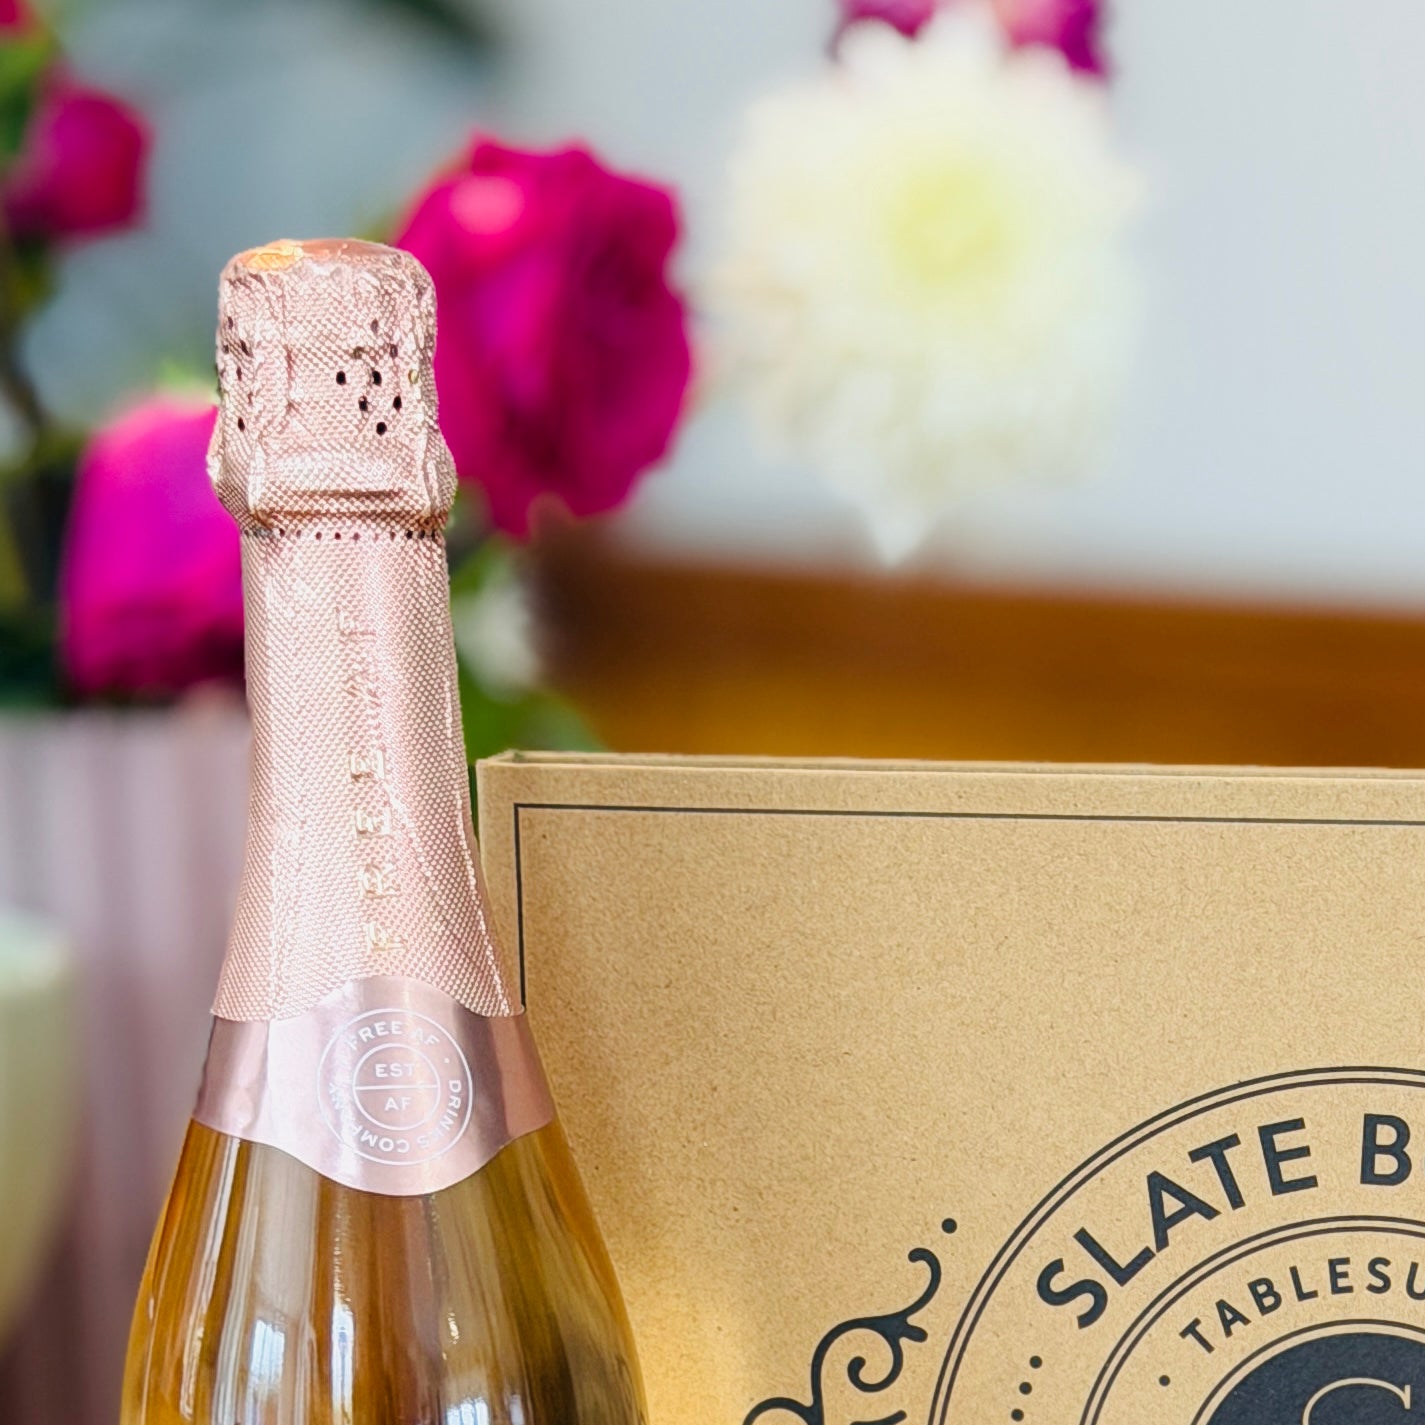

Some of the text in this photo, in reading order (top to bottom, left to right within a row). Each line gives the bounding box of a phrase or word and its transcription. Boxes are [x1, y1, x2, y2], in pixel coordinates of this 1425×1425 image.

[346, 1021, 403, 1050] FREE
[375, 1064, 415, 1078] EST
[385, 1097, 411, 1111] AF
[1037, 1116, 1318, 1329] SLATE
